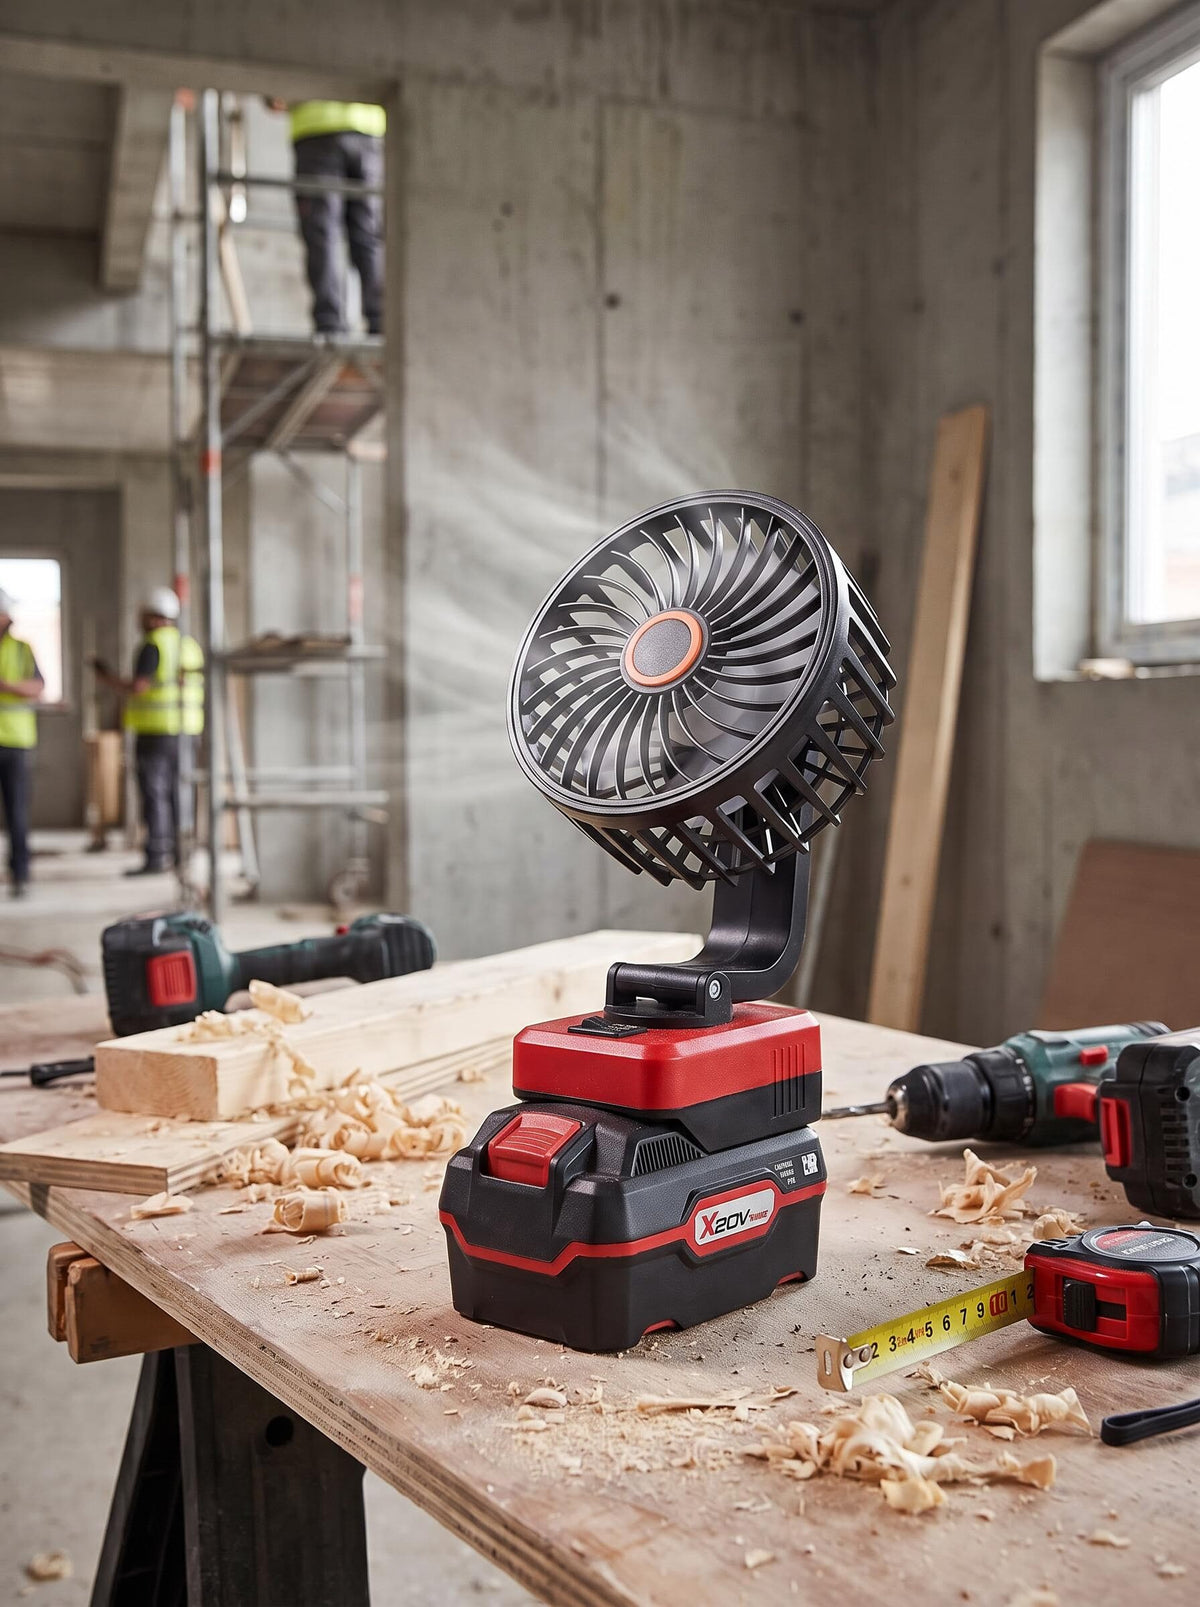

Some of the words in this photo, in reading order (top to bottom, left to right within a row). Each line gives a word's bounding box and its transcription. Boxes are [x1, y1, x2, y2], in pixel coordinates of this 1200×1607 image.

[700, 1208, 751, 1240] X20V
[870, 1342, 880, 1359] 2
[889, 1335, 897, 1352] 3
[907, 1328, 916, 1343] 4
[925, 1321, 933, 1338] 5
[942, 1315, 951, 1332] 6
[960, 1308, 968, 1325] 7
[976, 1302, 985, 1319] 9
[991, 1293, 1005, 1314] 10
[1010, 1289, 1017, 1306] 1
[1026, 1283, 1034, 1300] 2
